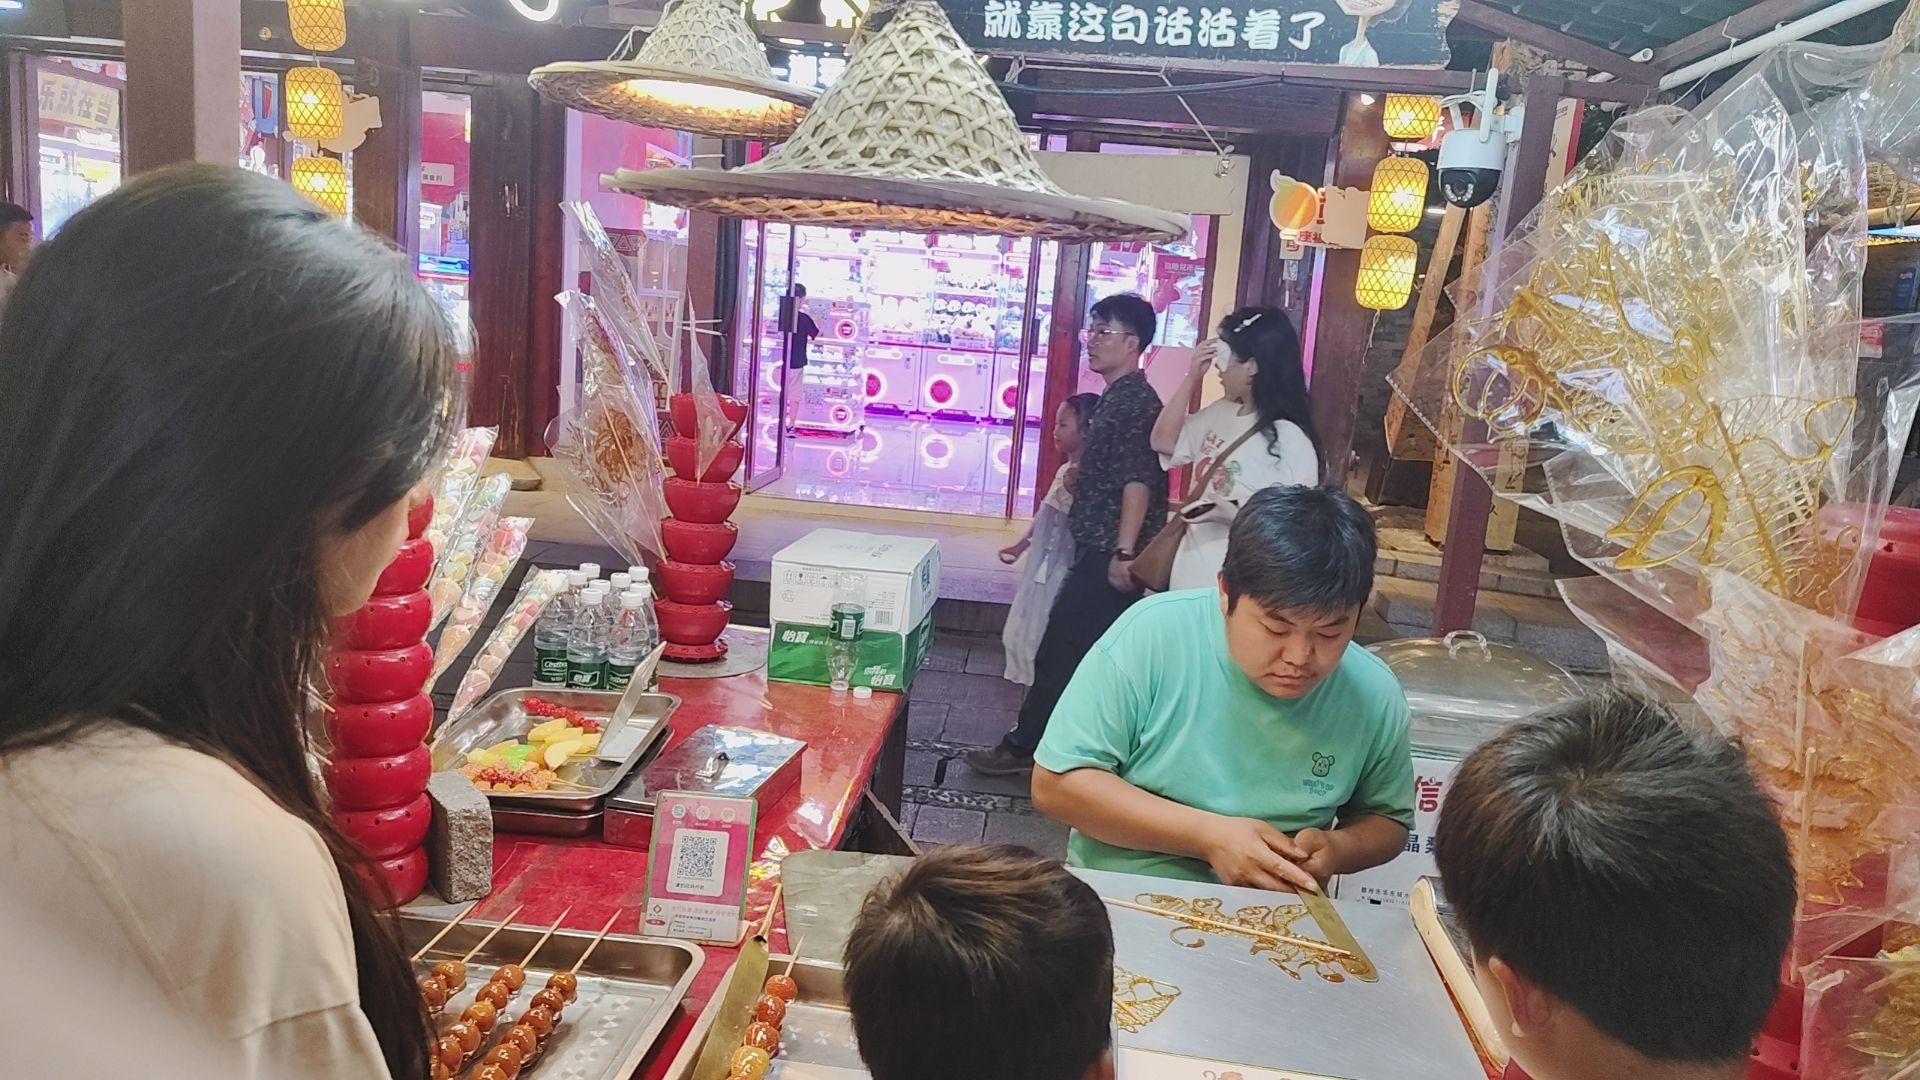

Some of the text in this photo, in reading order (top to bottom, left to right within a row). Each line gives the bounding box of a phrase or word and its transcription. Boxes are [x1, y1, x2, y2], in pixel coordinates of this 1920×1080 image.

[983, 0, 1326, 52] 就靠这句话活着了
